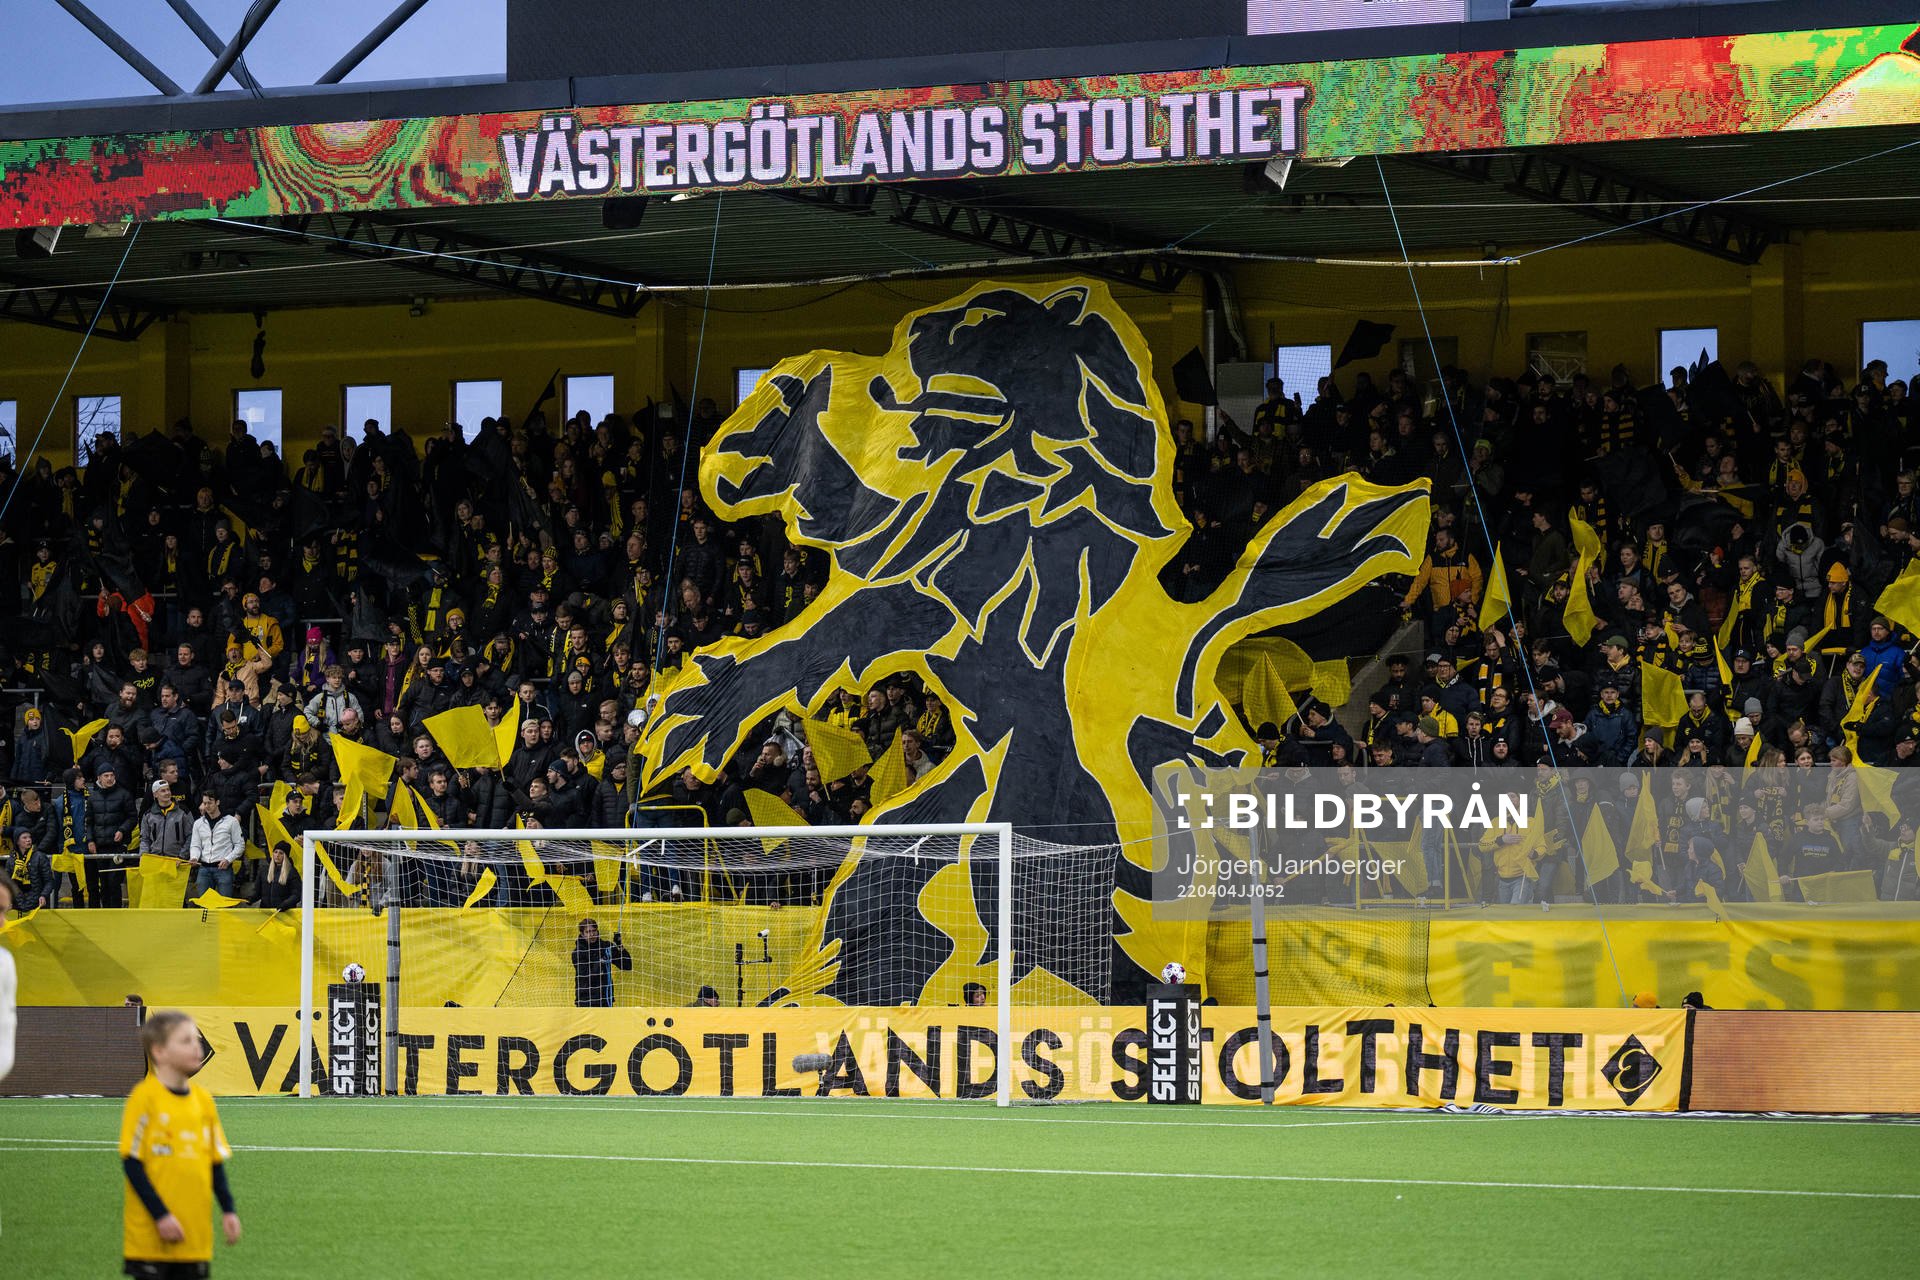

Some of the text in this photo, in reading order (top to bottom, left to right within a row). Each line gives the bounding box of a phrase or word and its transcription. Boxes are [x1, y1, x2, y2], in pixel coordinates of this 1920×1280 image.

[502, 87, 1306, 193] VÄSTERGÖTLANDS STOLTHET
[234, 1009, 1064, 1099] VÄTERGÖTLANDS
[1111, 1019, 1583, 1106] SOLTHET
[333, 998, 355, 1095] SELECT
[365, 998, 379, 1095] SELECT
[1152, 999, 1177, 1101] SELECT
[1187, 999, 1200, 1101] SELECT
